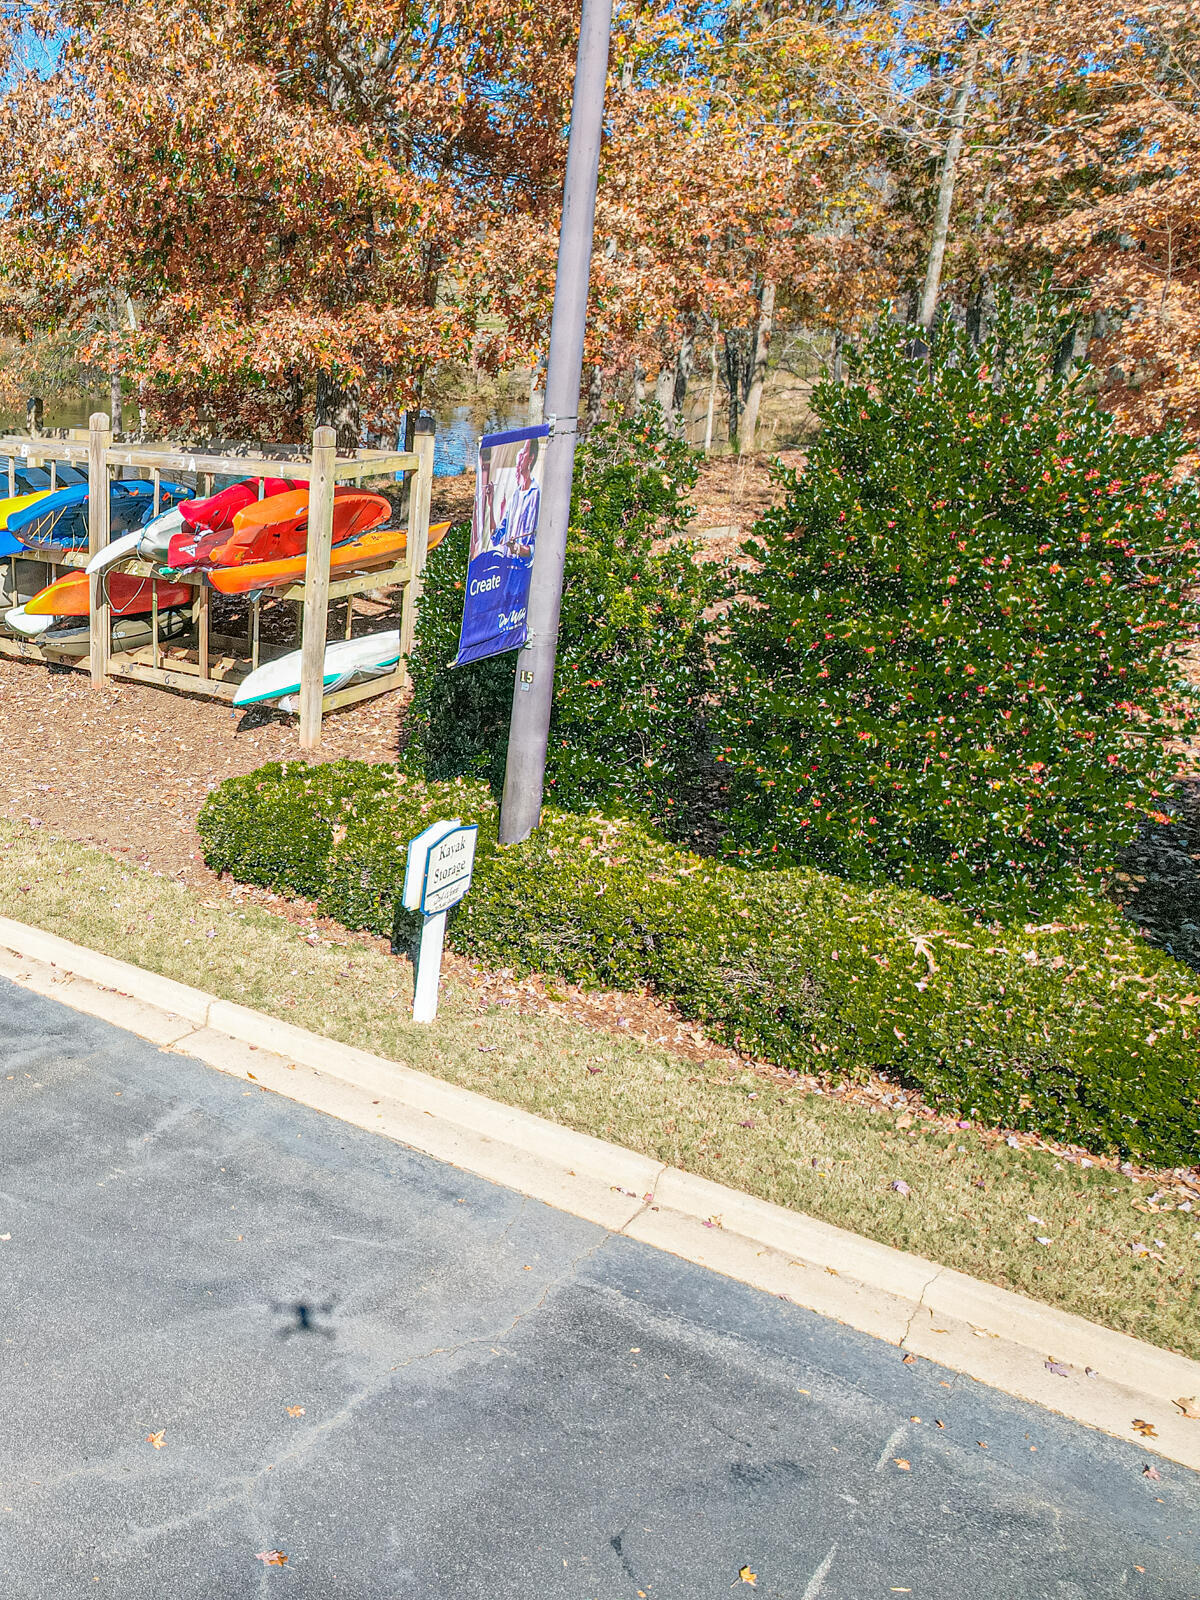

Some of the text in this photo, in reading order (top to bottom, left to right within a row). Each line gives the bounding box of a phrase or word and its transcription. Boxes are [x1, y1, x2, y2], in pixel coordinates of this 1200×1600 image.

[470, 574, 501, 596] Create
[521, 670, 533, 683] 15
[438, 835, 466, 861] Kayak
[433, 860, 466, 884] Storage
